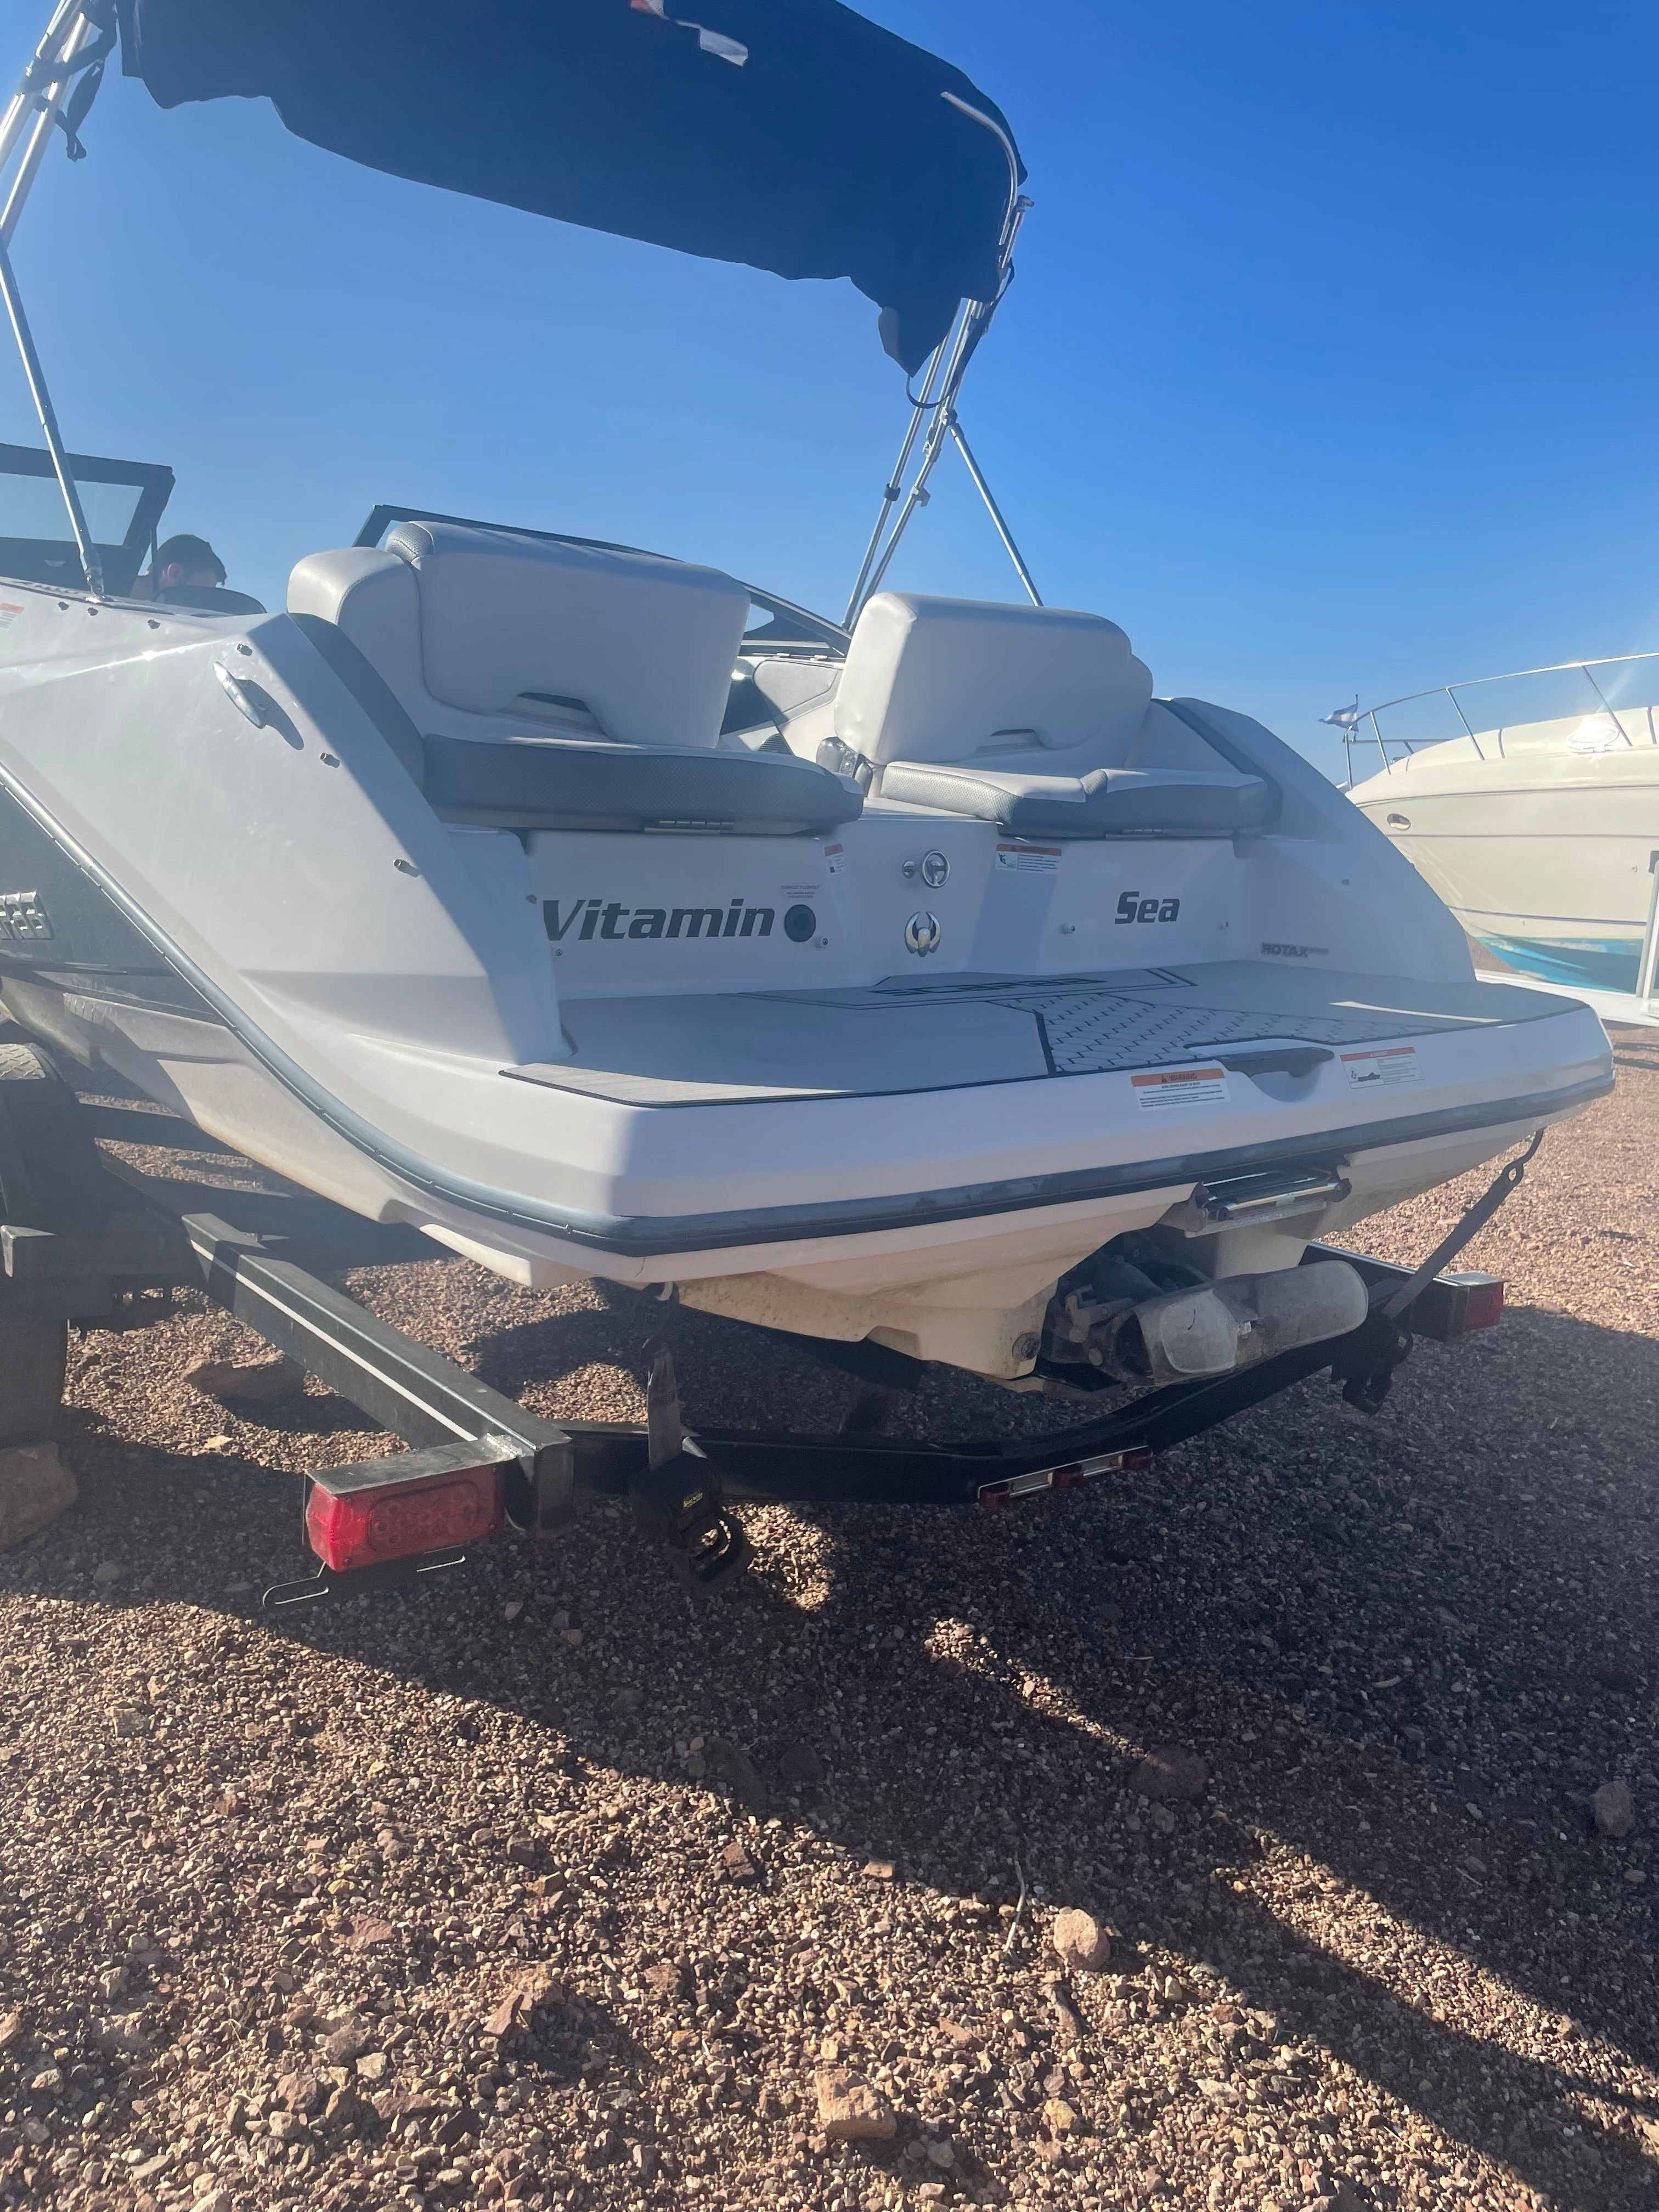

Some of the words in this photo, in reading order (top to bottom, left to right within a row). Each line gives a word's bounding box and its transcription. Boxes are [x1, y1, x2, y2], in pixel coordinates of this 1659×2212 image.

[543, 899, 775, 941] Vitamin
[1115, 891, 1180, 924] Sea
[1261, 943, 1308, 957] ROTAX
[1169, 1073, 1197, 1081] WARNING
